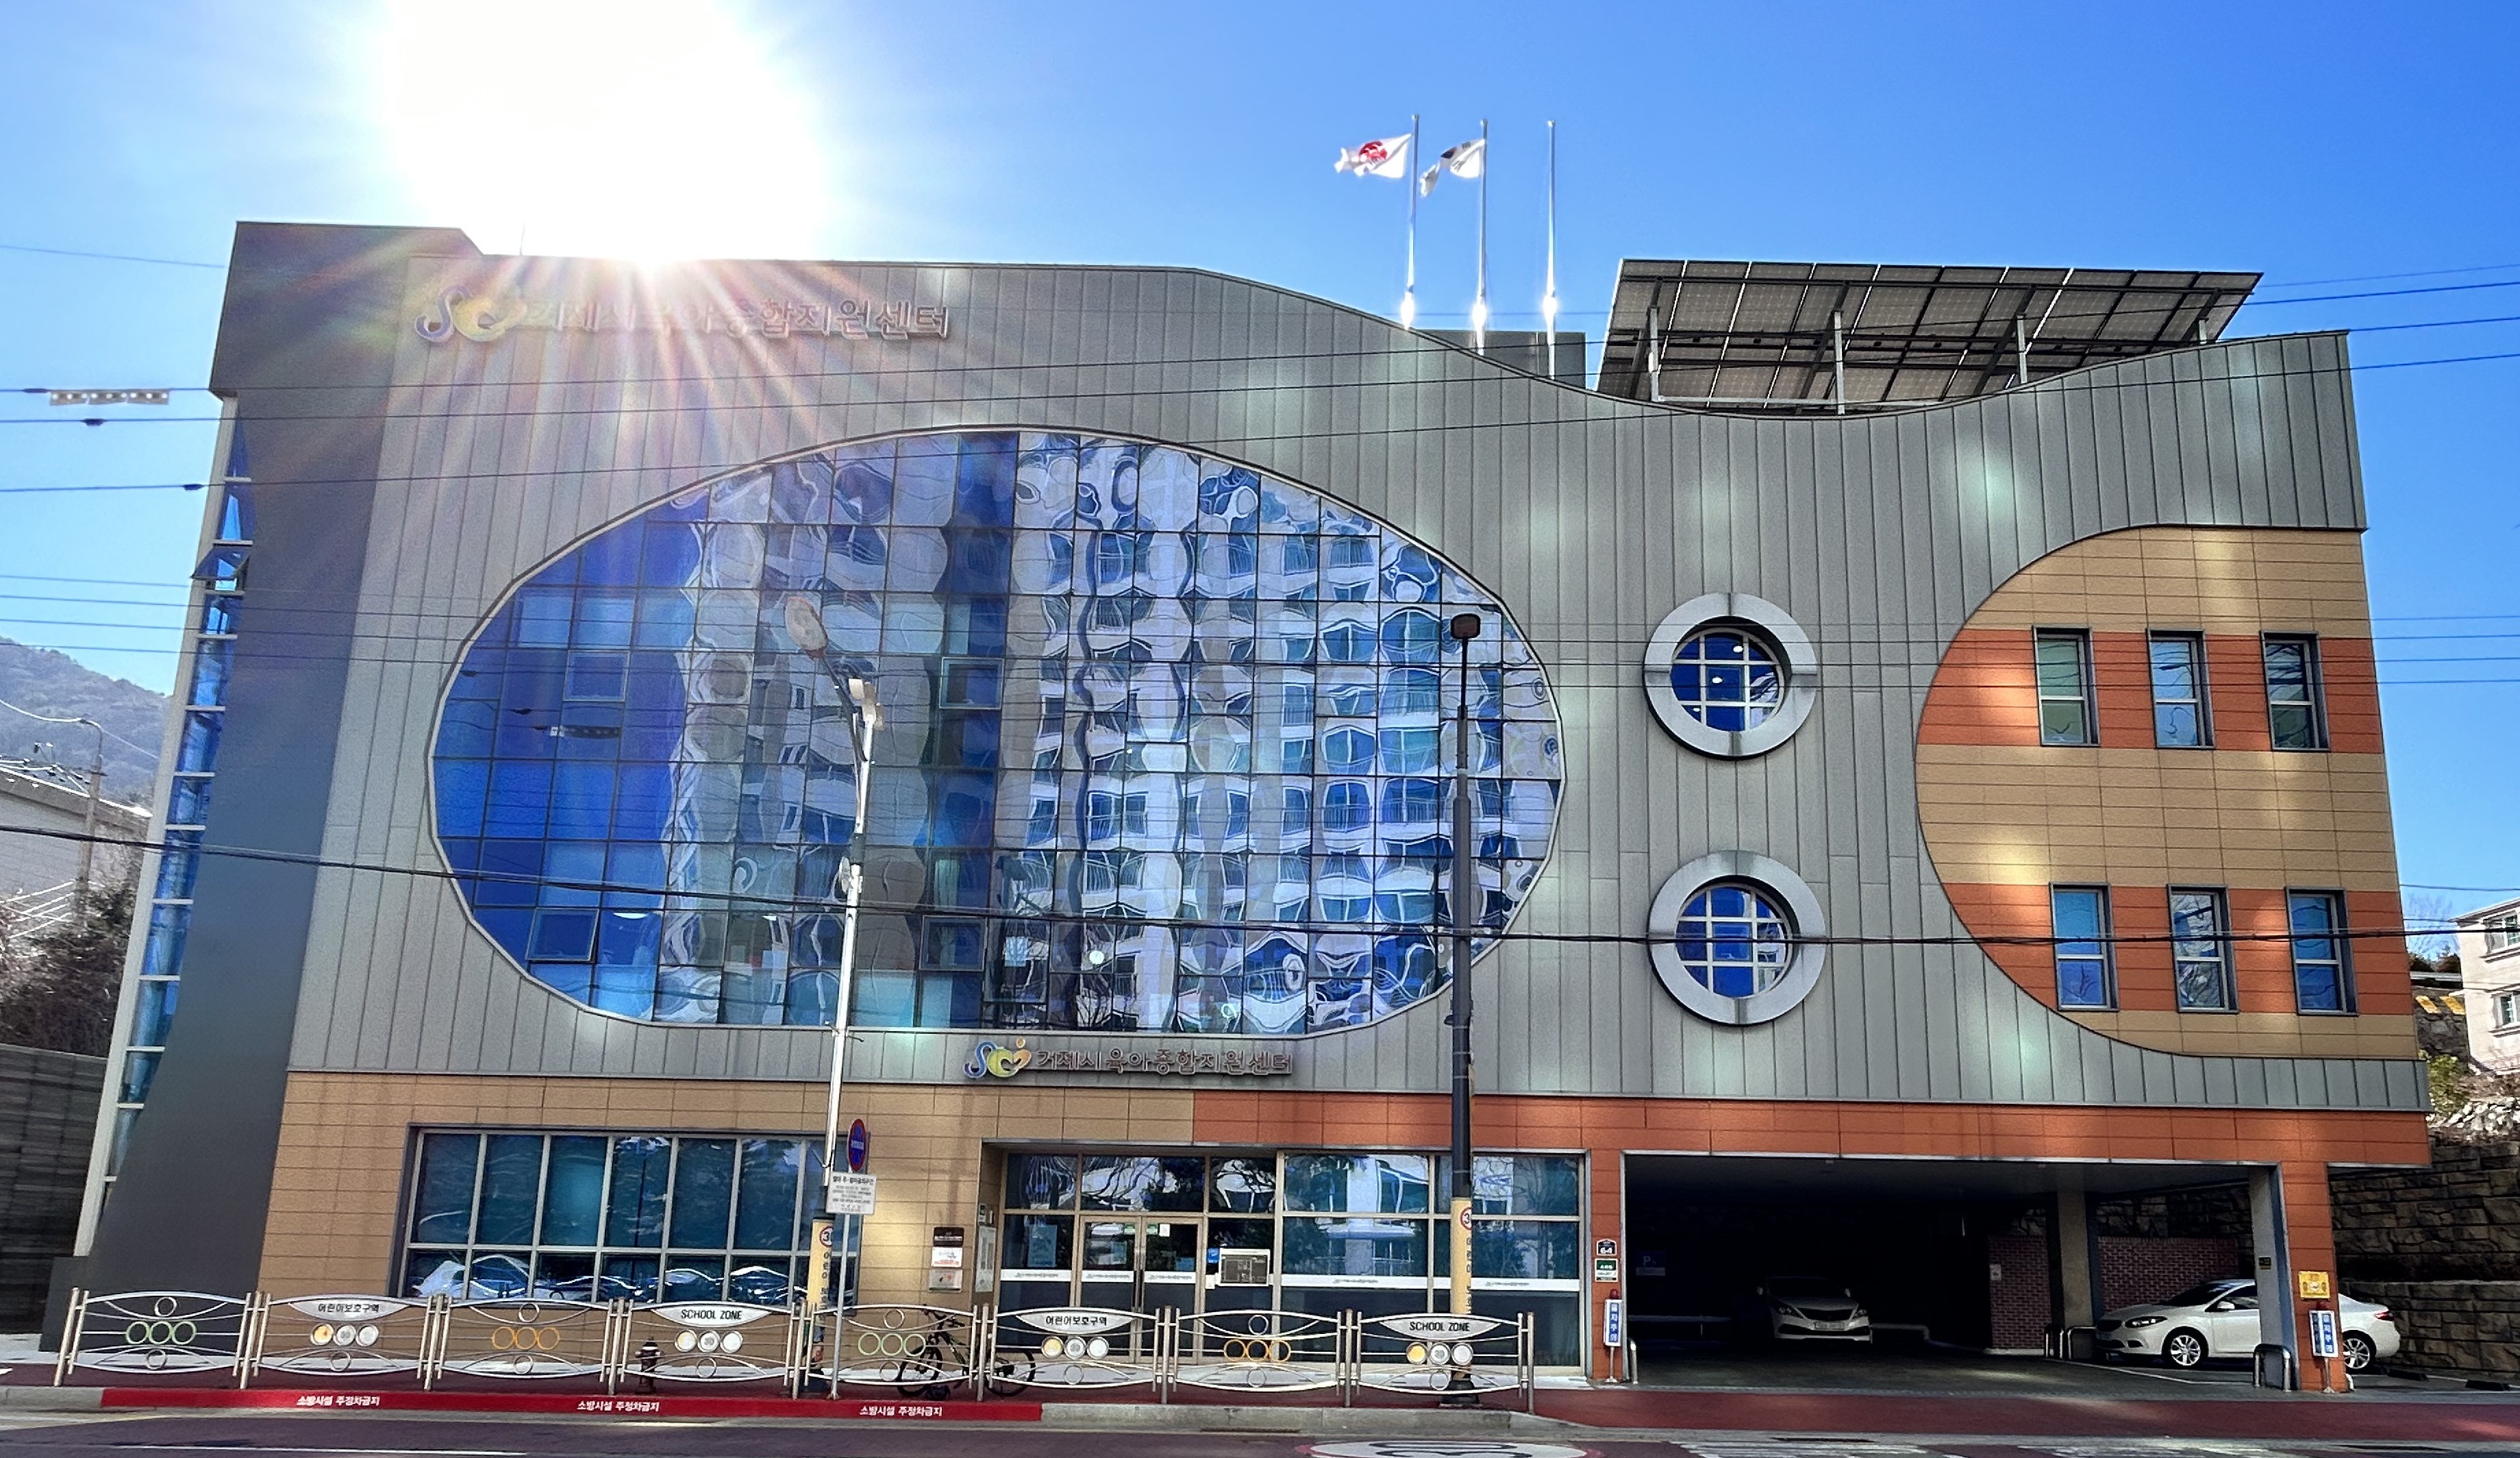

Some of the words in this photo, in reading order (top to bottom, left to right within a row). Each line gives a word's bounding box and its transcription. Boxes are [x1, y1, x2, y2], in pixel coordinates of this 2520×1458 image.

[529, 295, 951, 340] 거제시아종합지원센터
[1037, 1048, 1293, 1076] 거제시육아종합지원센터
[681, 1309, 716, 1319] SCHOOL
[720, 1310, 743, 1320] ZONE
[1045, 1315, 1107, 1326] 어린이보호구역
[1409, 1322, 1445, 1331] SCHOOL
[1448, 1322, 1470, 1331] ZONE
[297, 1395, 333, 1407] 소방시설
[336, 1395, 380, 1407] 주정차금지
[577, 1400, 612, 1411] 소방시설
[615, 1401, 660, 1412] 주정차금지
[860, 1405, 895, 1416] 소방시설
[898, 1406, 943, 1417] 주정차금지
